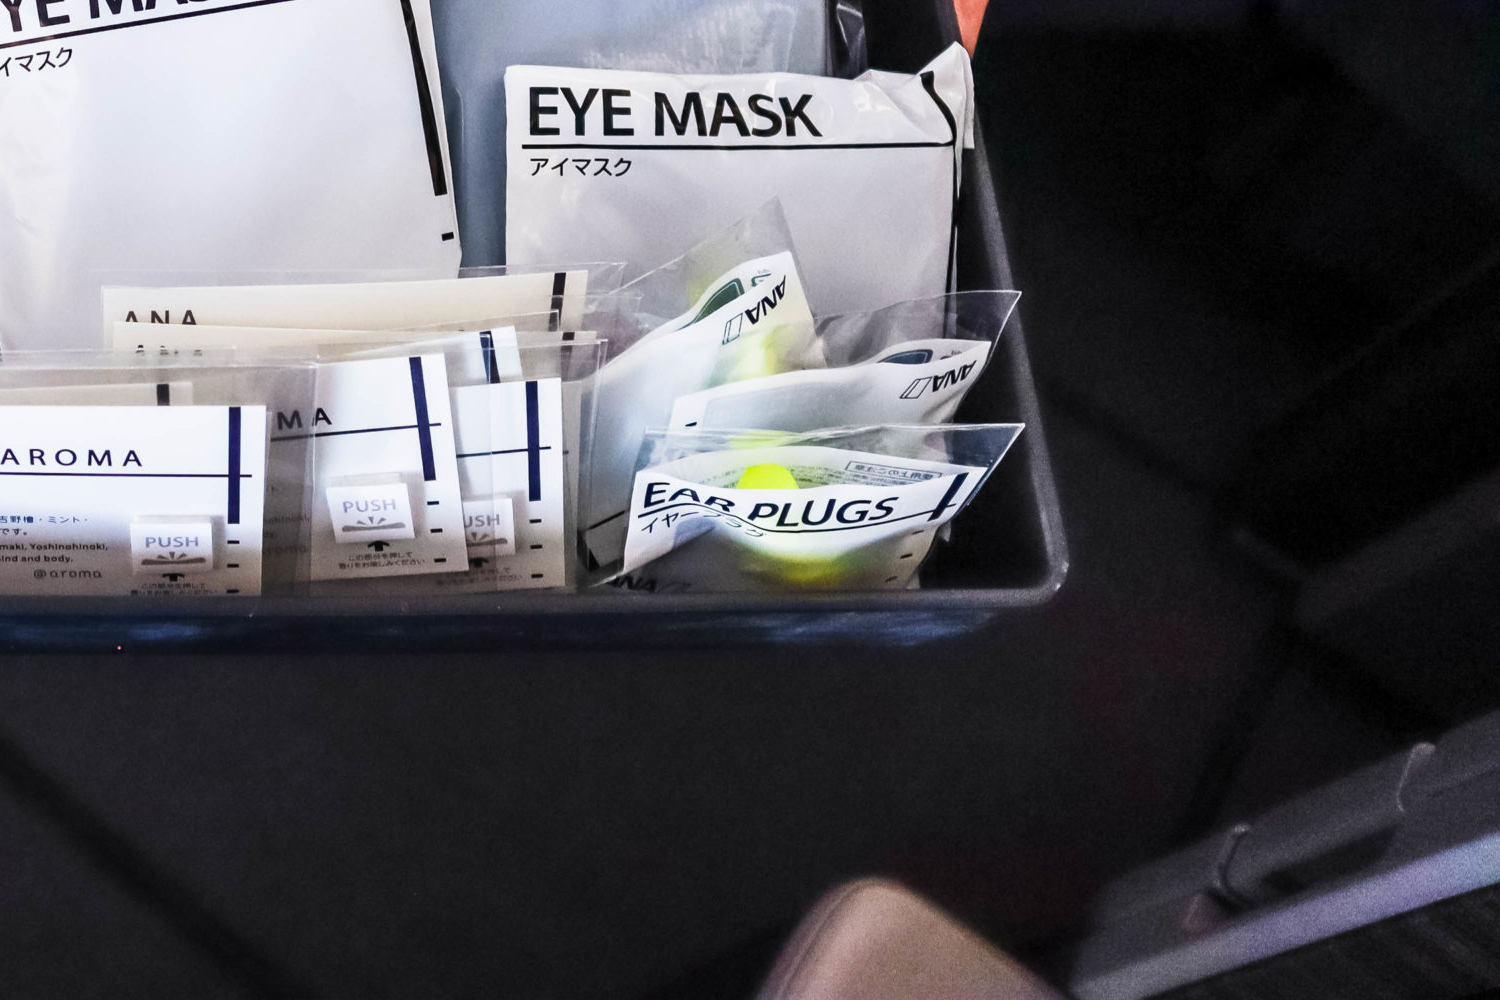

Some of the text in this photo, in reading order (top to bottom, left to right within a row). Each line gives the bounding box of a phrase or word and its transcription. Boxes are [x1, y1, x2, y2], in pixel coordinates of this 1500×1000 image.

[530, 86, 823, 137] EYE MASK
[530, 157, 632, 177] アイマスク
[745, 274, 787, 325] ANA
[931, 360, 977, 393] ANA
[0, 448, 144, 468] AROMA
[342, 498, 397, 514] PUSH
[644, 481, 900, 527] EAR PLUGS
[463, 514, 500, 529] USH
[144, 536, 200, 548] PUSH
[21, 554, 41, 564] and
